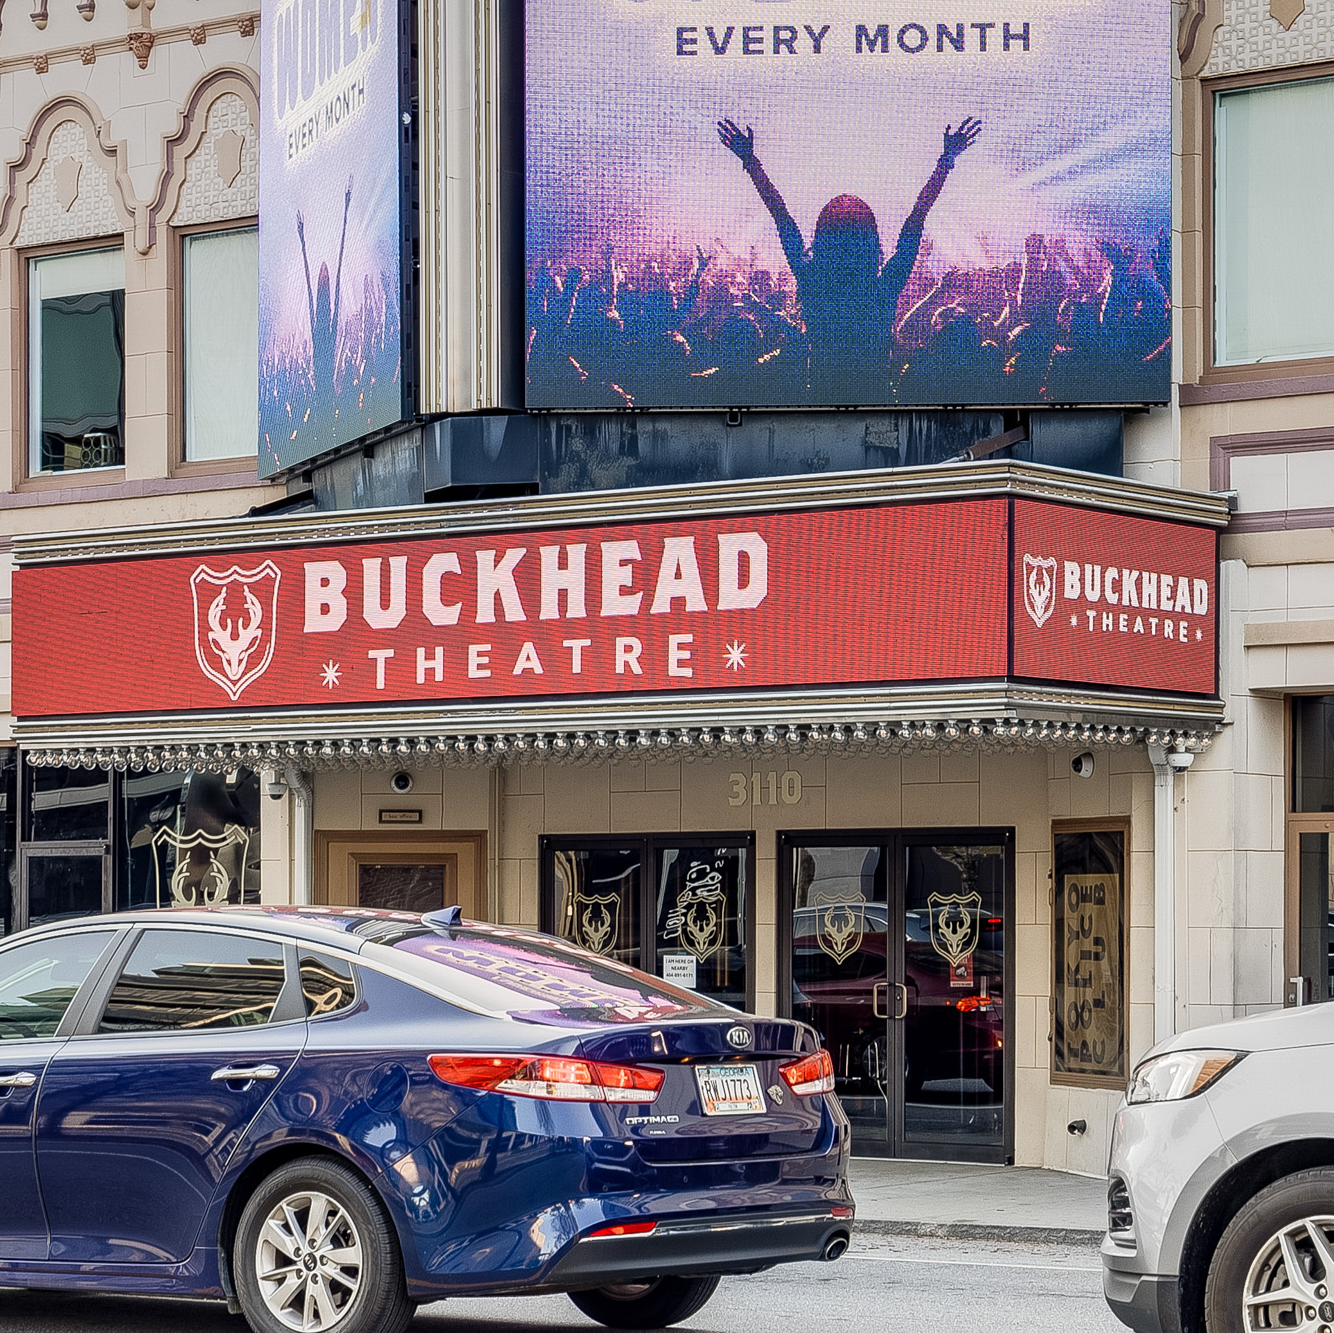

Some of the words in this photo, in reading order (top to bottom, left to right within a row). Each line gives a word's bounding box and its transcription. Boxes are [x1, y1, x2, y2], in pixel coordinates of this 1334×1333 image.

[675, 24, 831, 57] EVERY
[855, 22, 1031, 55] MONTH
[288, 109, 322, 160] EVERY
[325, 75, 365, 133] MONTH
[302, 531, 768, 634] BUCKHEAD
[1063, 560, 1209, 616] BUCKHEAD
[1085, 609, 1189, 643] THEATRE
[368, 633, 694, 690] THEATRE
[728, 771, 802, 806] 3110
[1067, 882, 1080, 1063] TOKYO
[1080, 884, 1093, 1063] POLICE
[1093, 882, 1106, 1064] CLUB
[732, 1031, 750, 1044] KIA
[624, 1115, 667, 1125] OPTIMA
